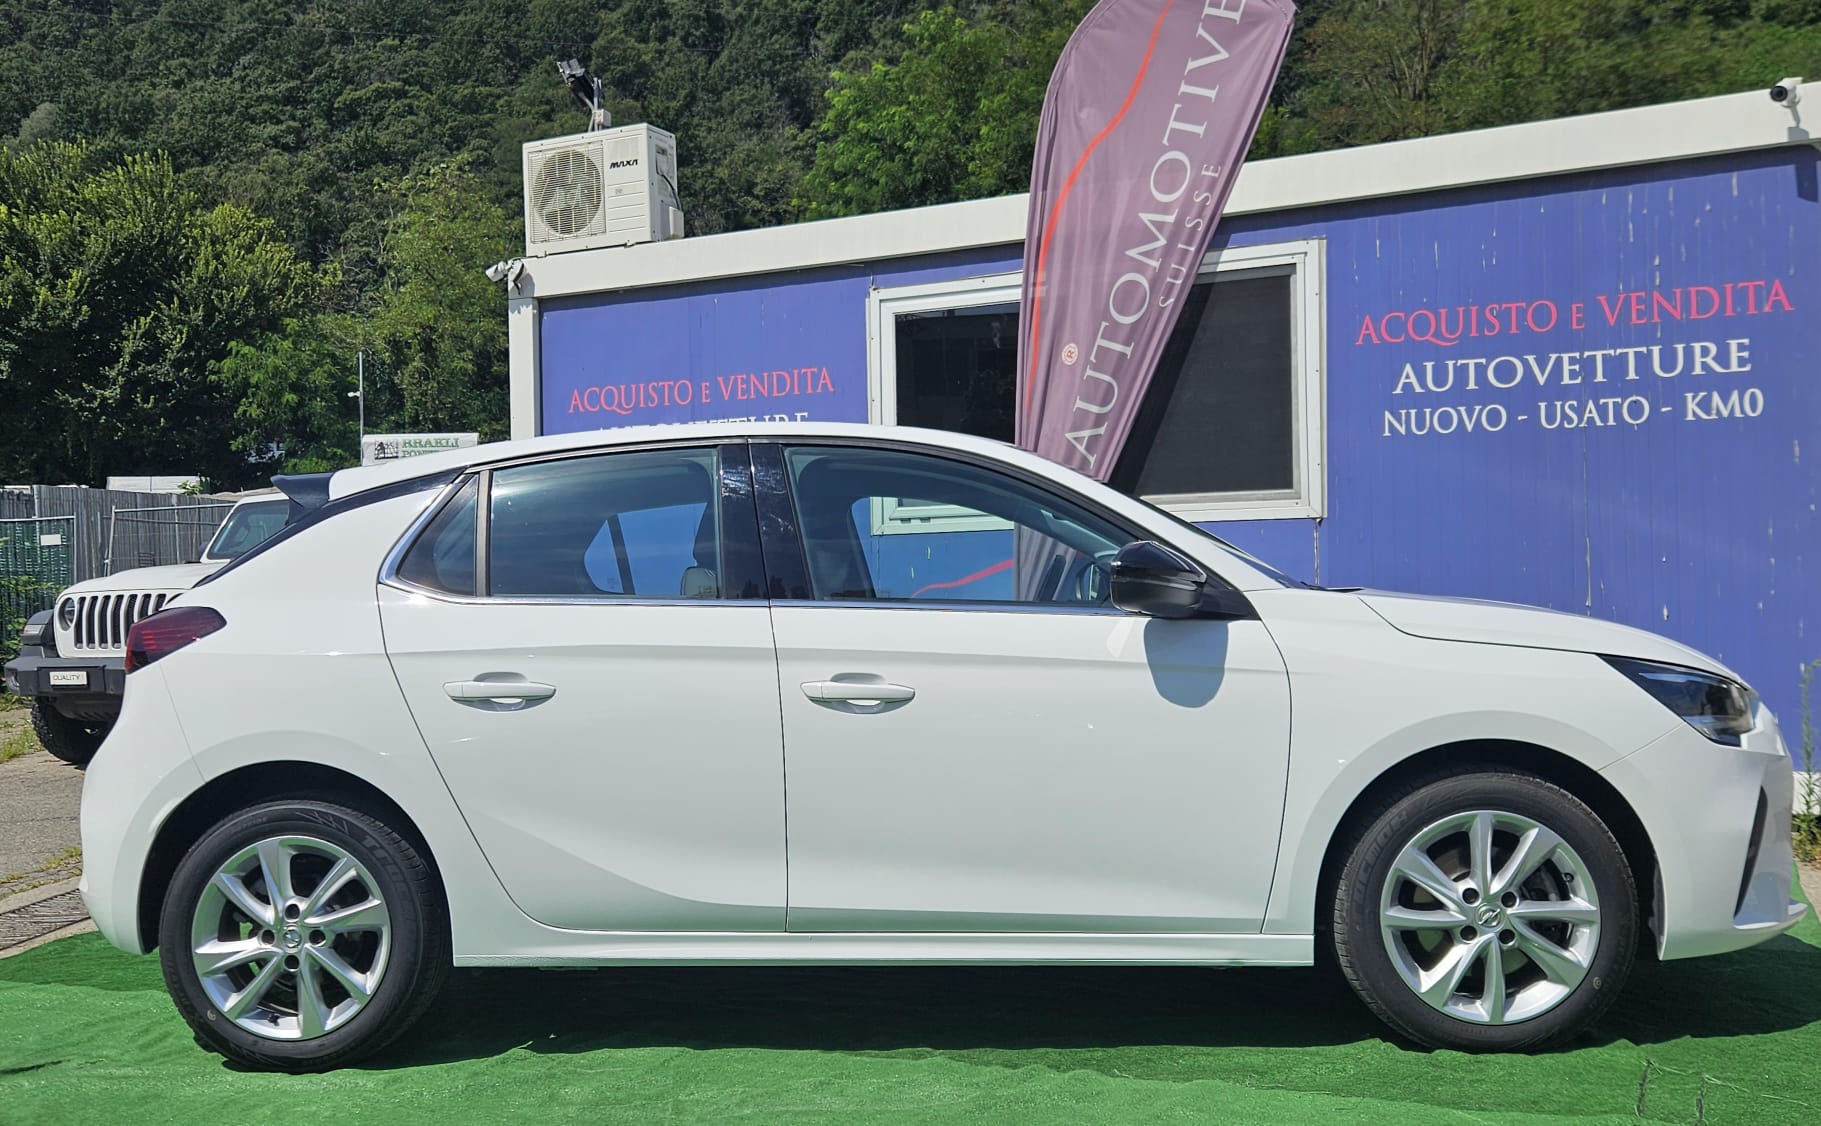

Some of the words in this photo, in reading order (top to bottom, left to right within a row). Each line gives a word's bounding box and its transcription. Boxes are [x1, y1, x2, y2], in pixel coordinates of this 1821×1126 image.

[1064, 0, 1247, 469] AUTOMOTIVE
[1158, 163, 1221, 308] SUISSE
[1355, 300, 1558, 347] ACQUISTO
[1570, 304, 1585, 330] E
[1597, 279, 1795, 327] VENDITA
[568, 379, 693, 415] ACQUISTO
[701, 381, 711, 403] E
[717, 367, 835, 401] VENDITA
[1392, 338, 1752, 394] AUTOVETTURE
[1382, 404, 1507, 436] NUOVO
[1538, 396, 1650, 429] USATO
